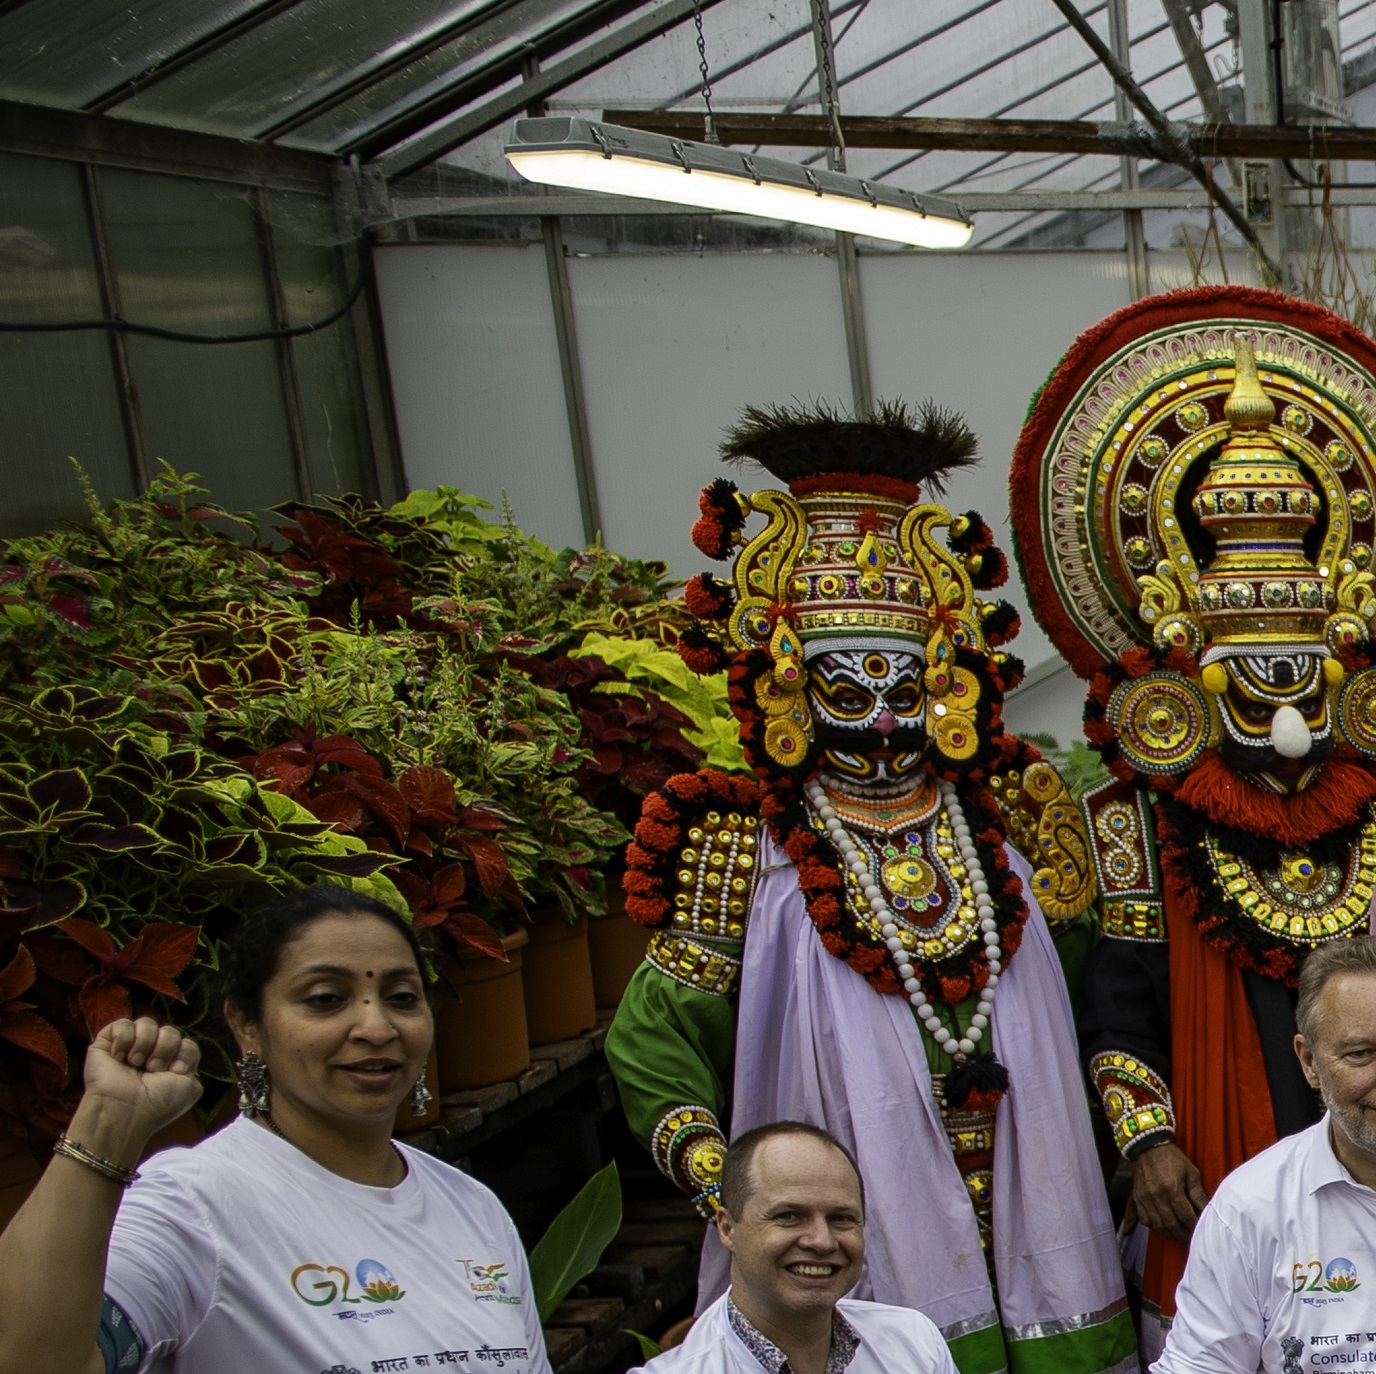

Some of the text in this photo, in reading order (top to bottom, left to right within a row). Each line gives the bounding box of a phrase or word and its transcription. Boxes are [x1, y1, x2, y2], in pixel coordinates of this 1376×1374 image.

[1310, 1335, 1338, 1347] भारत
[1345, 1334, 1360, 1345] का
[371, 1356, 409, 1373] भारत
[413, 1354, 431, 1367] का
[434, 1350, 469, 1365] प्रधान
